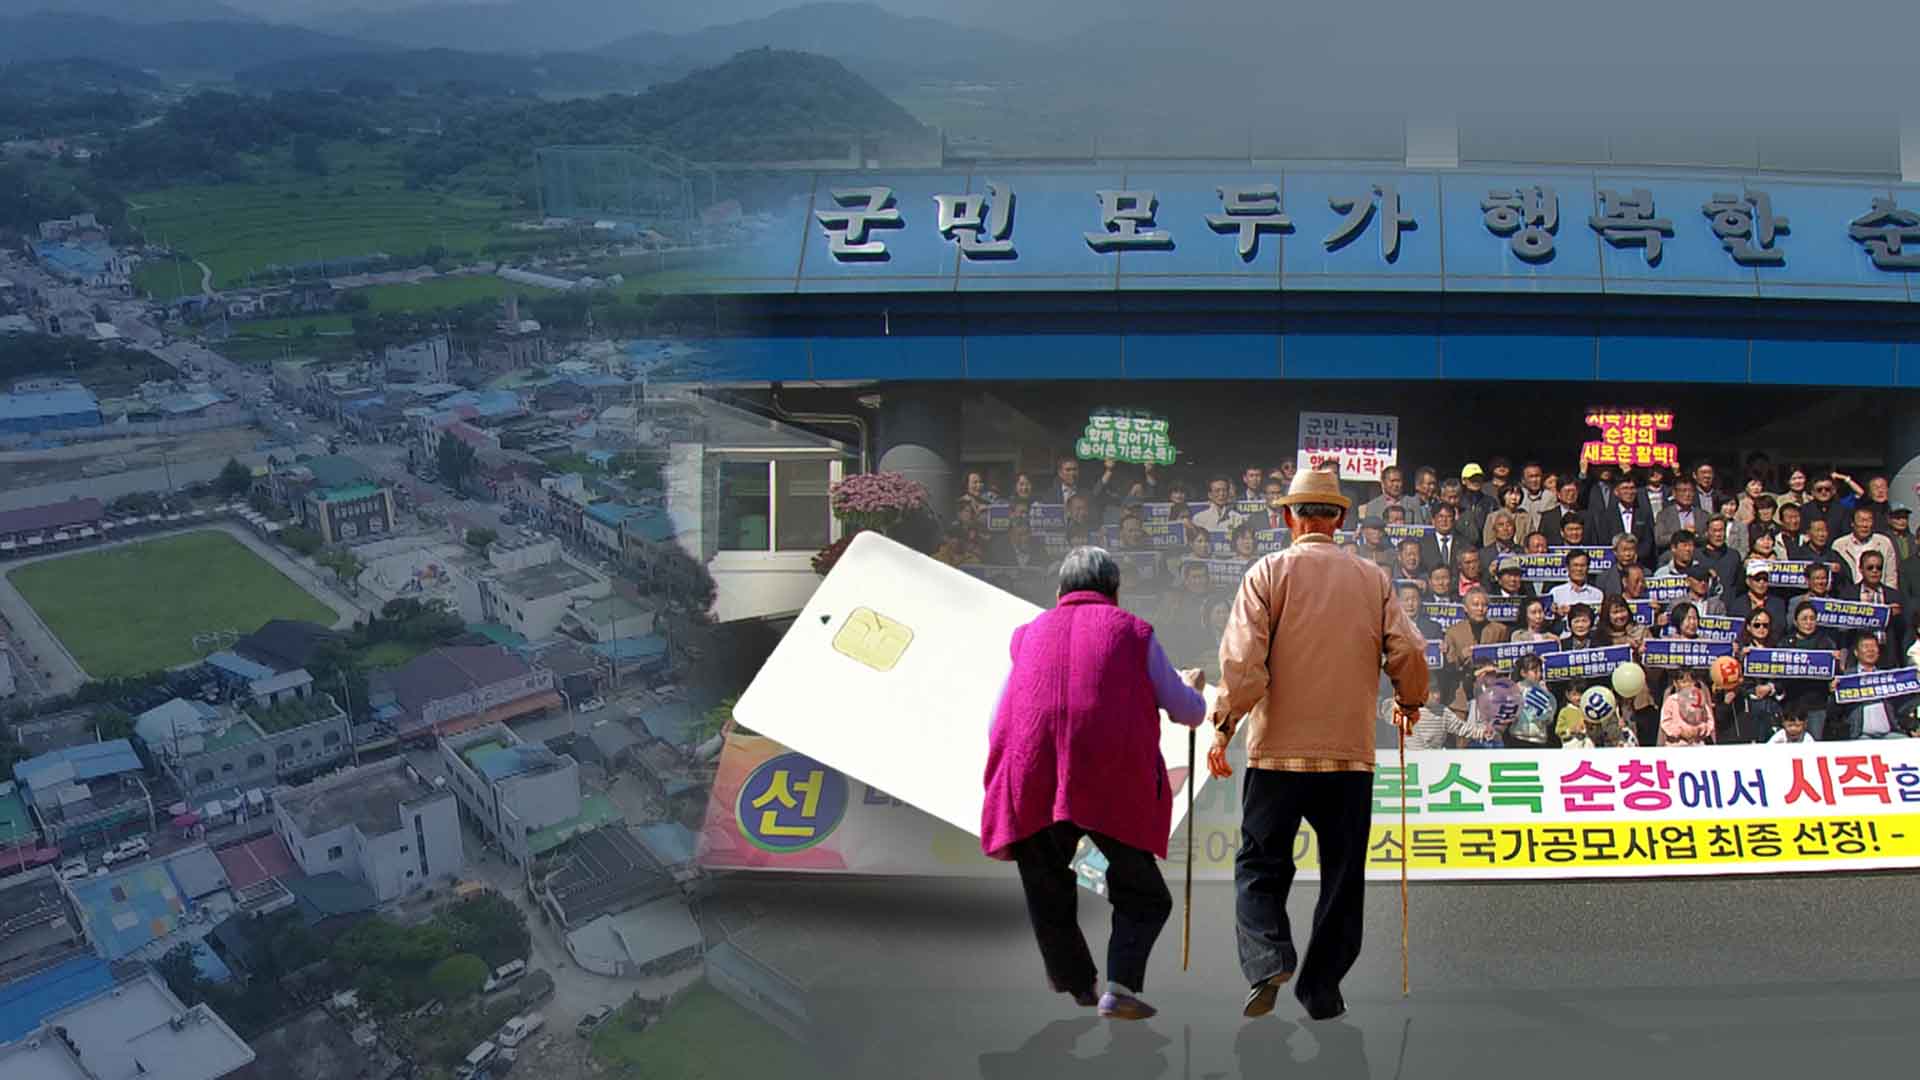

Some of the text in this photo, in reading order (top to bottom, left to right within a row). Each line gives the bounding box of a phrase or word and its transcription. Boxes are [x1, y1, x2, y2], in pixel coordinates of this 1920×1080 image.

[815, 183, 1019, 262] 군민
[1084, 183, 1417, 264] 모두가
[1480, 184, 1790, 267] 행복한
[1306, 418, 1392, 438] 군민 누구나
[1605, 426, 1654, 444] 순창의
[1346, 457, 1384, 475] 시작!
[1583, 444, 1674, 465] 새로운 활력!
[1372, 762, 1545, 815] 본소득
[1559, 759, 1769, 813] 순창에서
[752, 770, 824, 837] 선
[1460, 825, 1698, 864] 국가공모사업
[1708, 823, 1782, 859] 최종
[1793, 820, 1881, 856] 선정!
